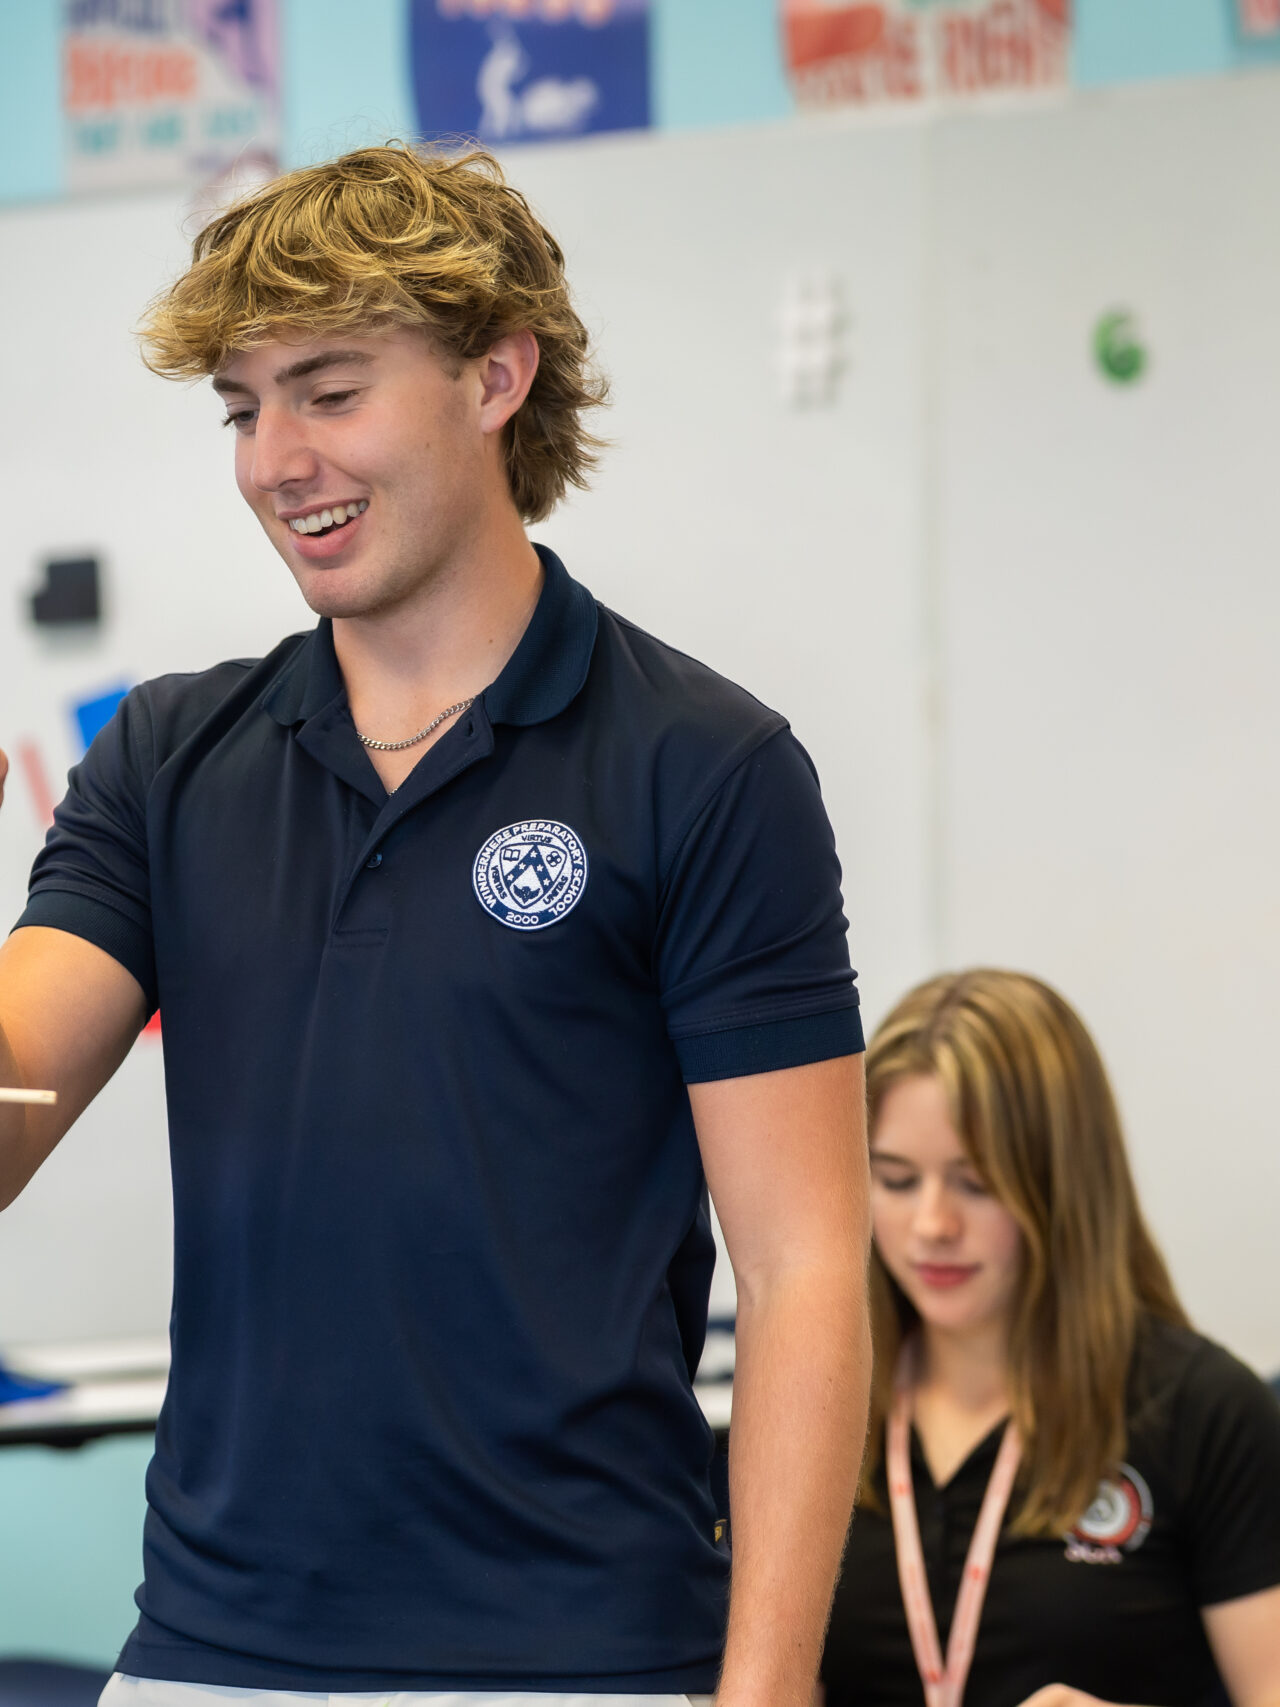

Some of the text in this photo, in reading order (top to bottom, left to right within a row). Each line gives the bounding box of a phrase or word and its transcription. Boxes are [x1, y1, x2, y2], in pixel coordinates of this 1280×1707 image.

[1092, 305, 1146, 387] 6
[521, 834, 553, 844] VIRTUS
[477, 822, 584, 916] WINDERMERE PREPARATORY SCHOOL
[505, 911, 539, 925] 2000
